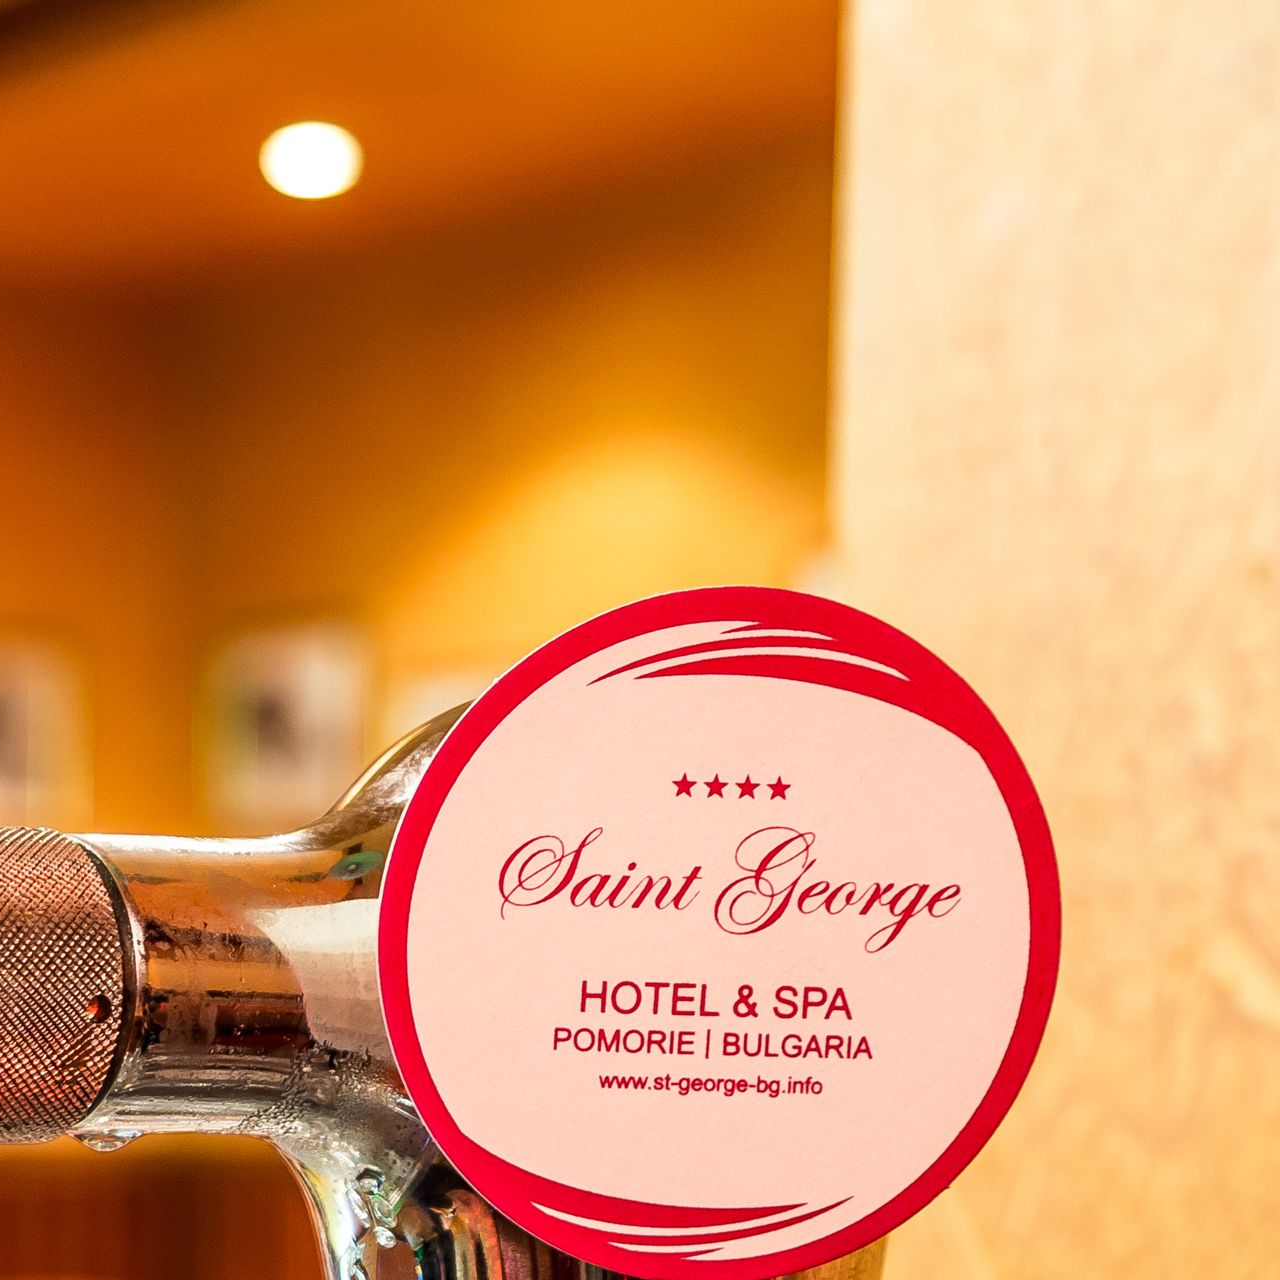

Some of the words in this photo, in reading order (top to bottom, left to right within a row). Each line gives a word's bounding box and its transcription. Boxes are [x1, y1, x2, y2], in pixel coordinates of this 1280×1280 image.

[497, 826, 703, 920] Saint
[713, 825, 962, 954] George
[579, 979, 721, 1018] HOTEL
[732, 983, 759, 1019] &
[772, 985, 853, 1021] SPA
[552, 1026, 696, 1056] POMORIE
[722, 1031, 874, 1060] BULGARIA
[598, 1073, 824, 1099] www.st-george-bg.info
